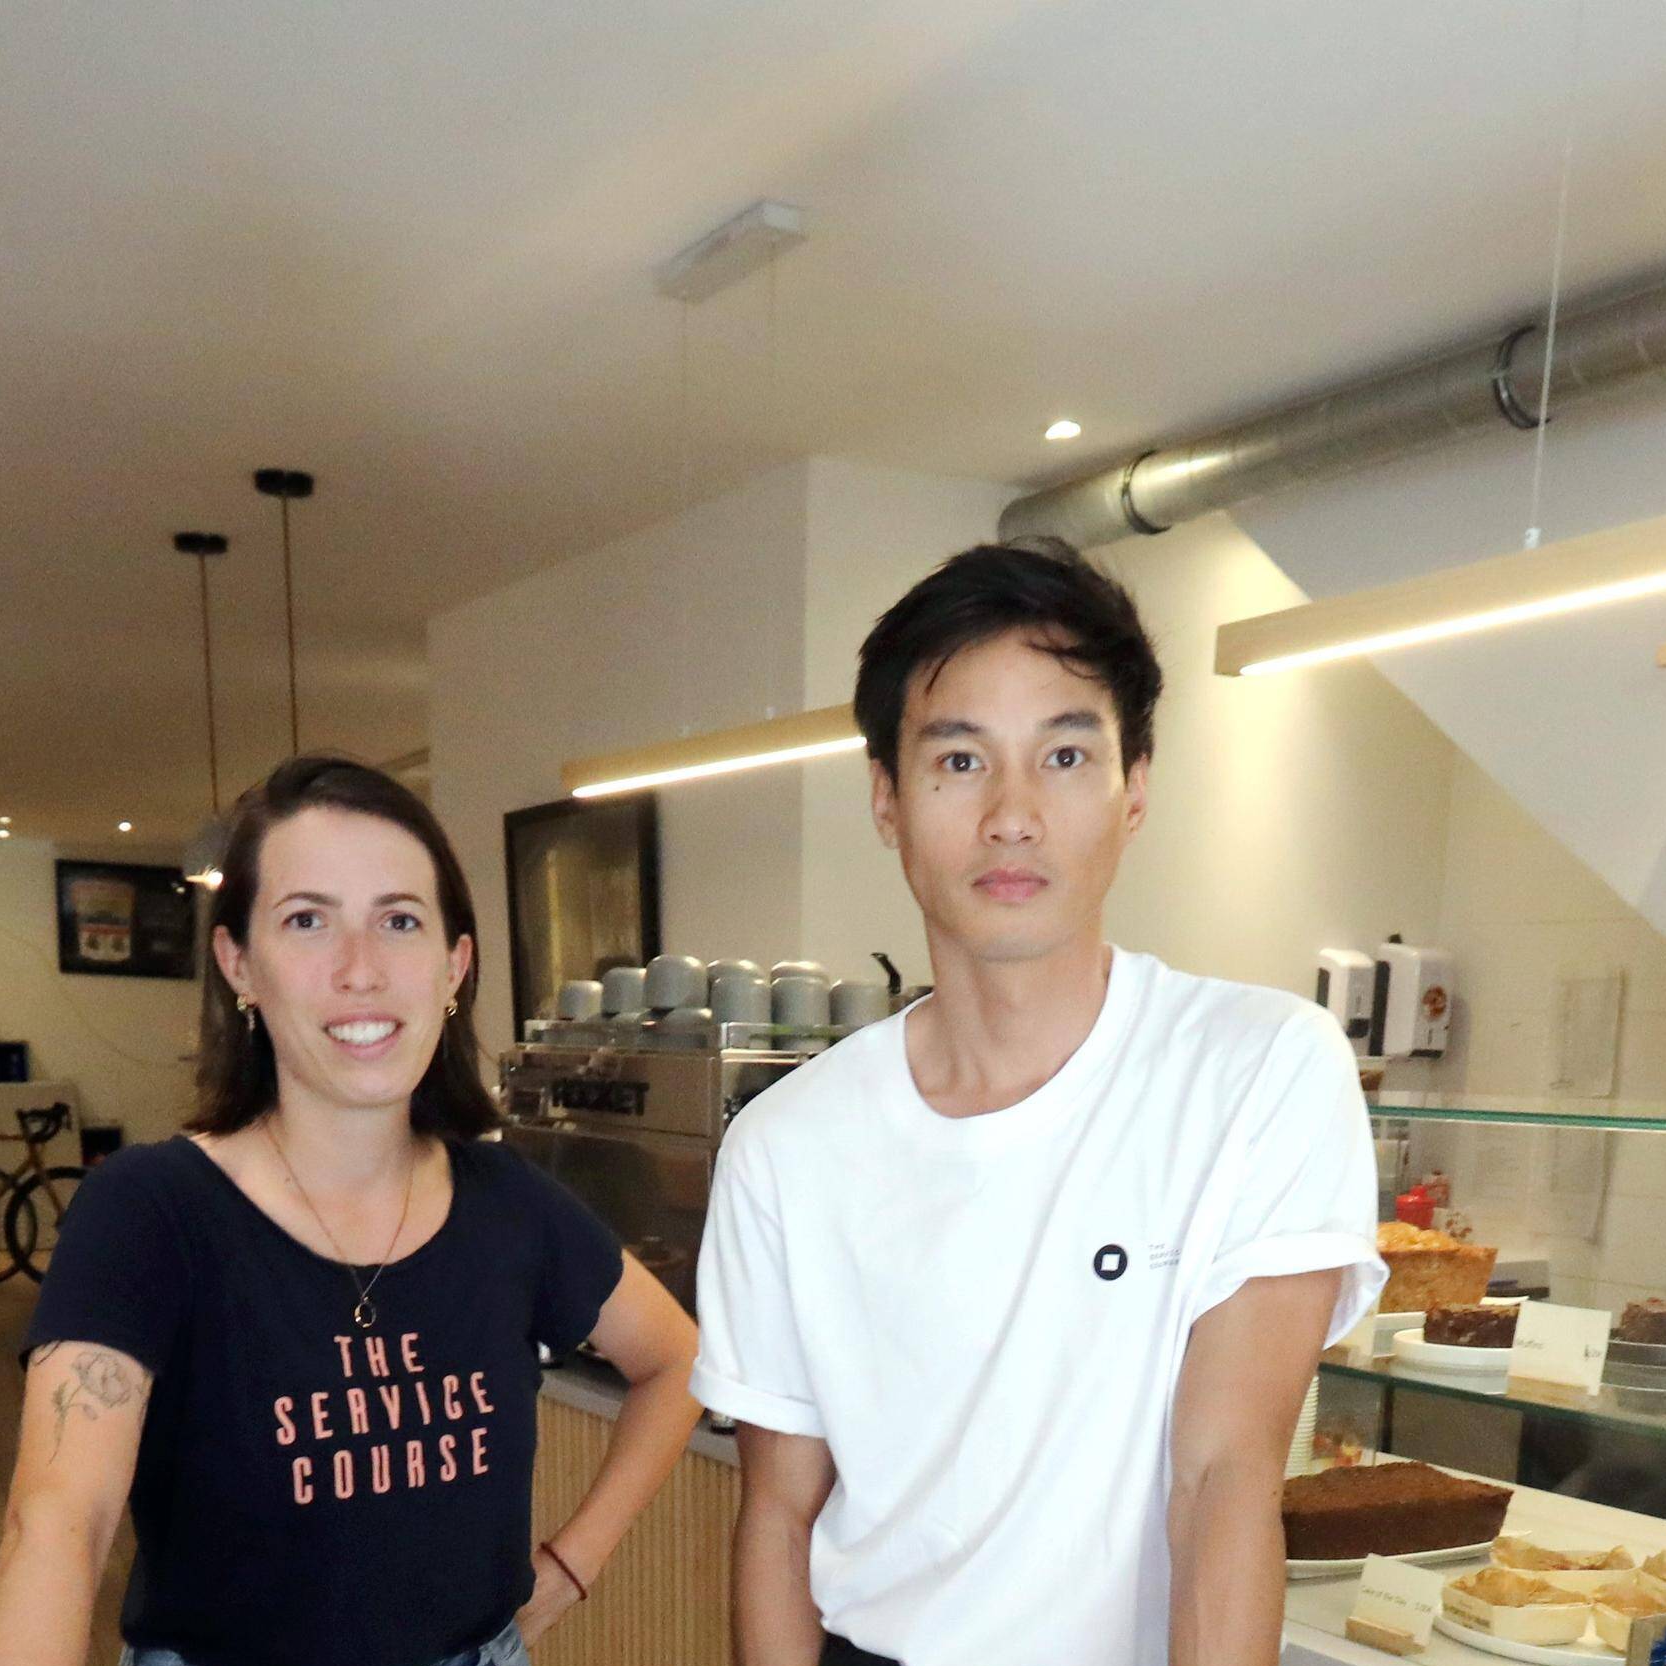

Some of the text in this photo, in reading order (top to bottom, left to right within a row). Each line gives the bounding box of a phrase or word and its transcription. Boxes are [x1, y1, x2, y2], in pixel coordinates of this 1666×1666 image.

[334, 1332, 425, 1378] THE
[274, 1371, 495, 1446] SERVICE
[292, 1427, 489, 1505] COURSE
